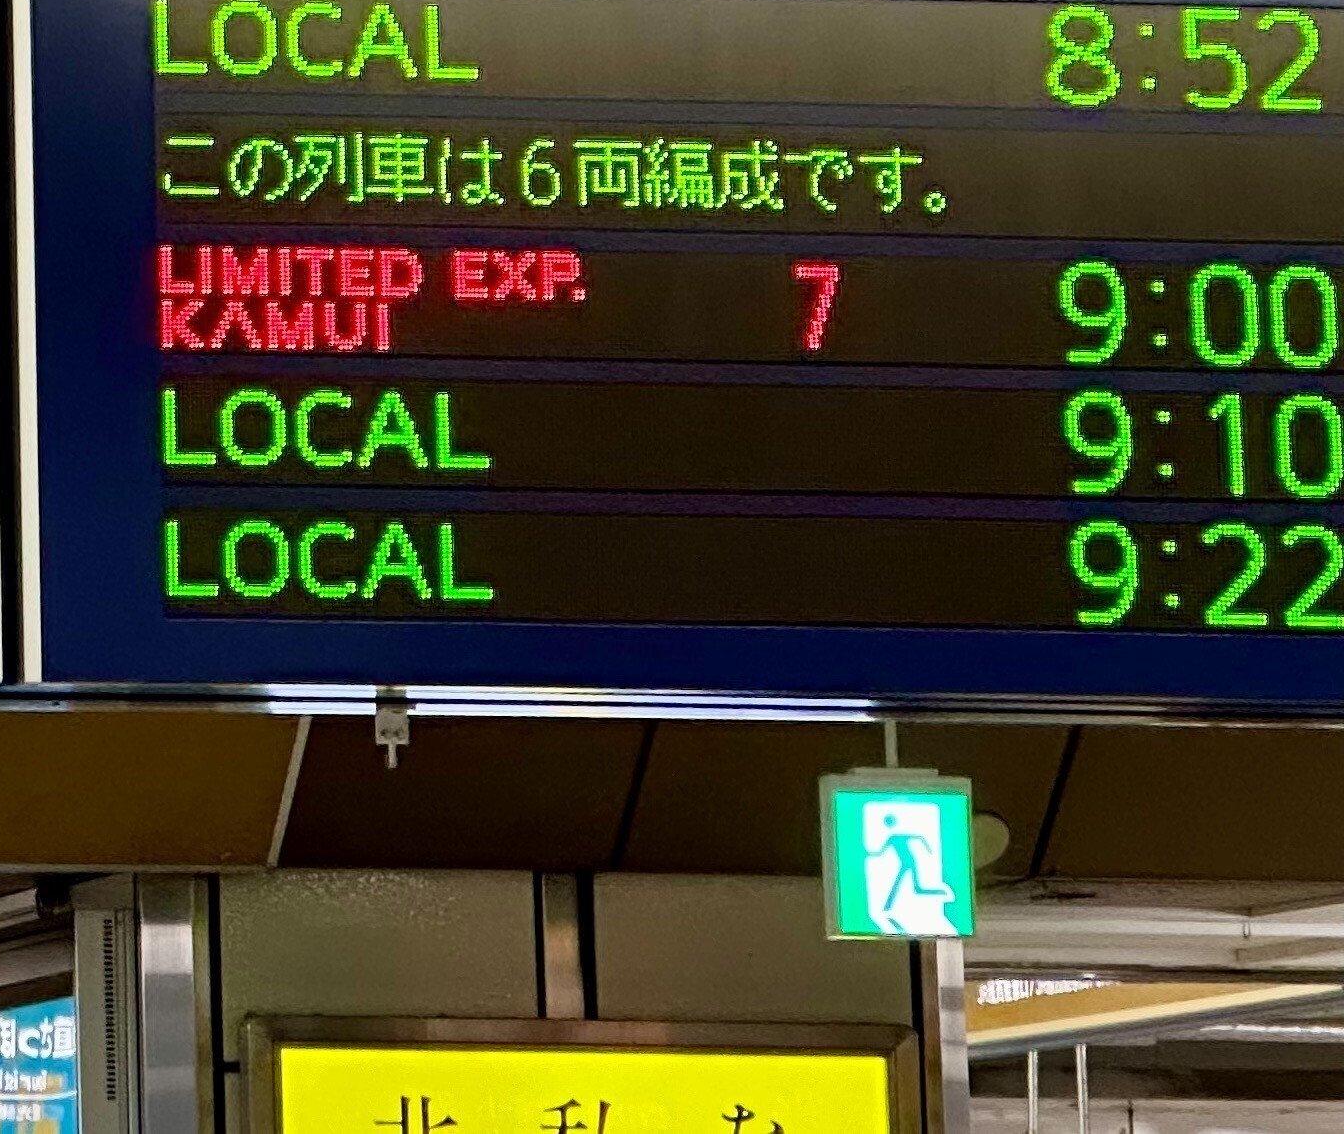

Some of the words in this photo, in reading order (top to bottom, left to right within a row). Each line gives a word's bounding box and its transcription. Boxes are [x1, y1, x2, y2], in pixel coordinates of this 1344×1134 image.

[154, 0, 476, 79] LOCAL
[1047, 5, 1321, 111] 8:52
[159, 245, 423, 299] LIMITED
[453, 250, 587, 301] EXP.
[795, 265, 838, 348] 7
[1060, 262, 1338, 368] 9:00
[159, 299, 391, 351] KAMUI
[163, 390, 490, 468] LOCAL
[1064, 391, 1344, 498] 9:10
[166, 521, 493, 599] LOCAL
[1070, 521, 1344, 629] 9:22
